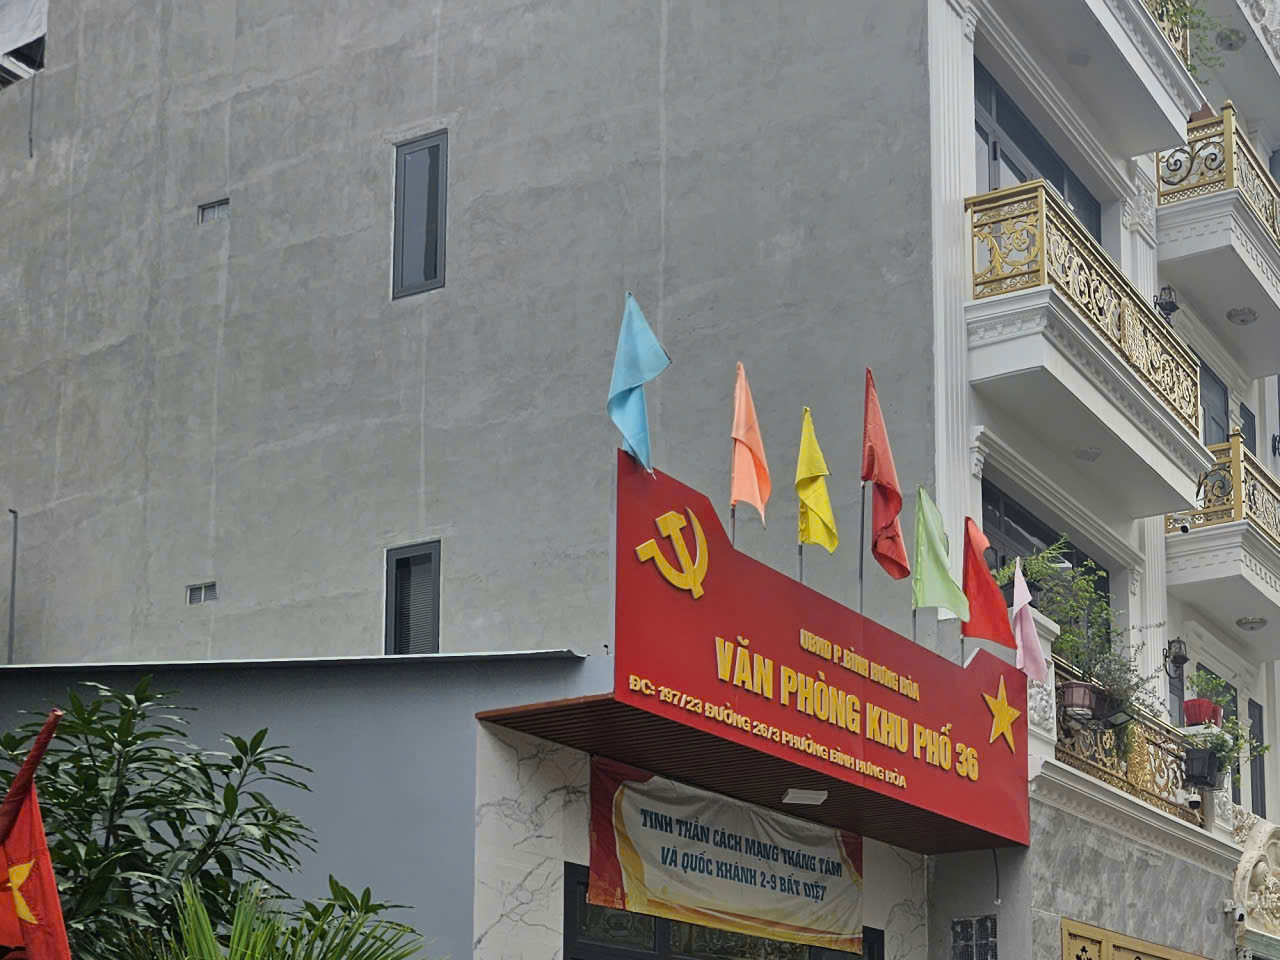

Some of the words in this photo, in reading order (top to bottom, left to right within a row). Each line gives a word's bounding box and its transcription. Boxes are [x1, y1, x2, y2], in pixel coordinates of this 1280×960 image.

[800, 628, 832, 660] UBND
[899, 674, 920, 701] HÒA
[629, 674, 656, 695] ĐC:
[658, 686, 703, 714] 197/23
[704, 702, 751, 732] ĐƯỜNG
[752, 721, 780, 742] 26/3
[781, 731, 829, 760] PHƯỜNG
[829, 746, 855, 769] BÌNH
[855, 758, 885, 780] HƯNG
[885, 768, 907, 788] HÒA
[715, 635, 774, 700] VĂN
[780, 665, 861, 734] PHÒNG
[866, 702, 909, 753] KHU
[913, 722, 952, 771] PHỐ
[955, 742, 979, 781] 36
[640, 808, 673, 834] TINH
[675, 816, 710, 844] THẦN
[712, 827, 742, 853] CÁCH
[744, 837, 779, 862] MẠNG
[780, 847, 816, 872] THÁNG
[818, 856, 843, 878] TÁM
[661, 845, 678, 868] VÀ
[681, 850, 713, 876] QUỐC
[716, 860, 757, 886] KHÁNH
[760, 871, 777, 890] 2-9
[779, 872, 801, 896] BẤT
[803, 880, 828, 904] DIỆT
